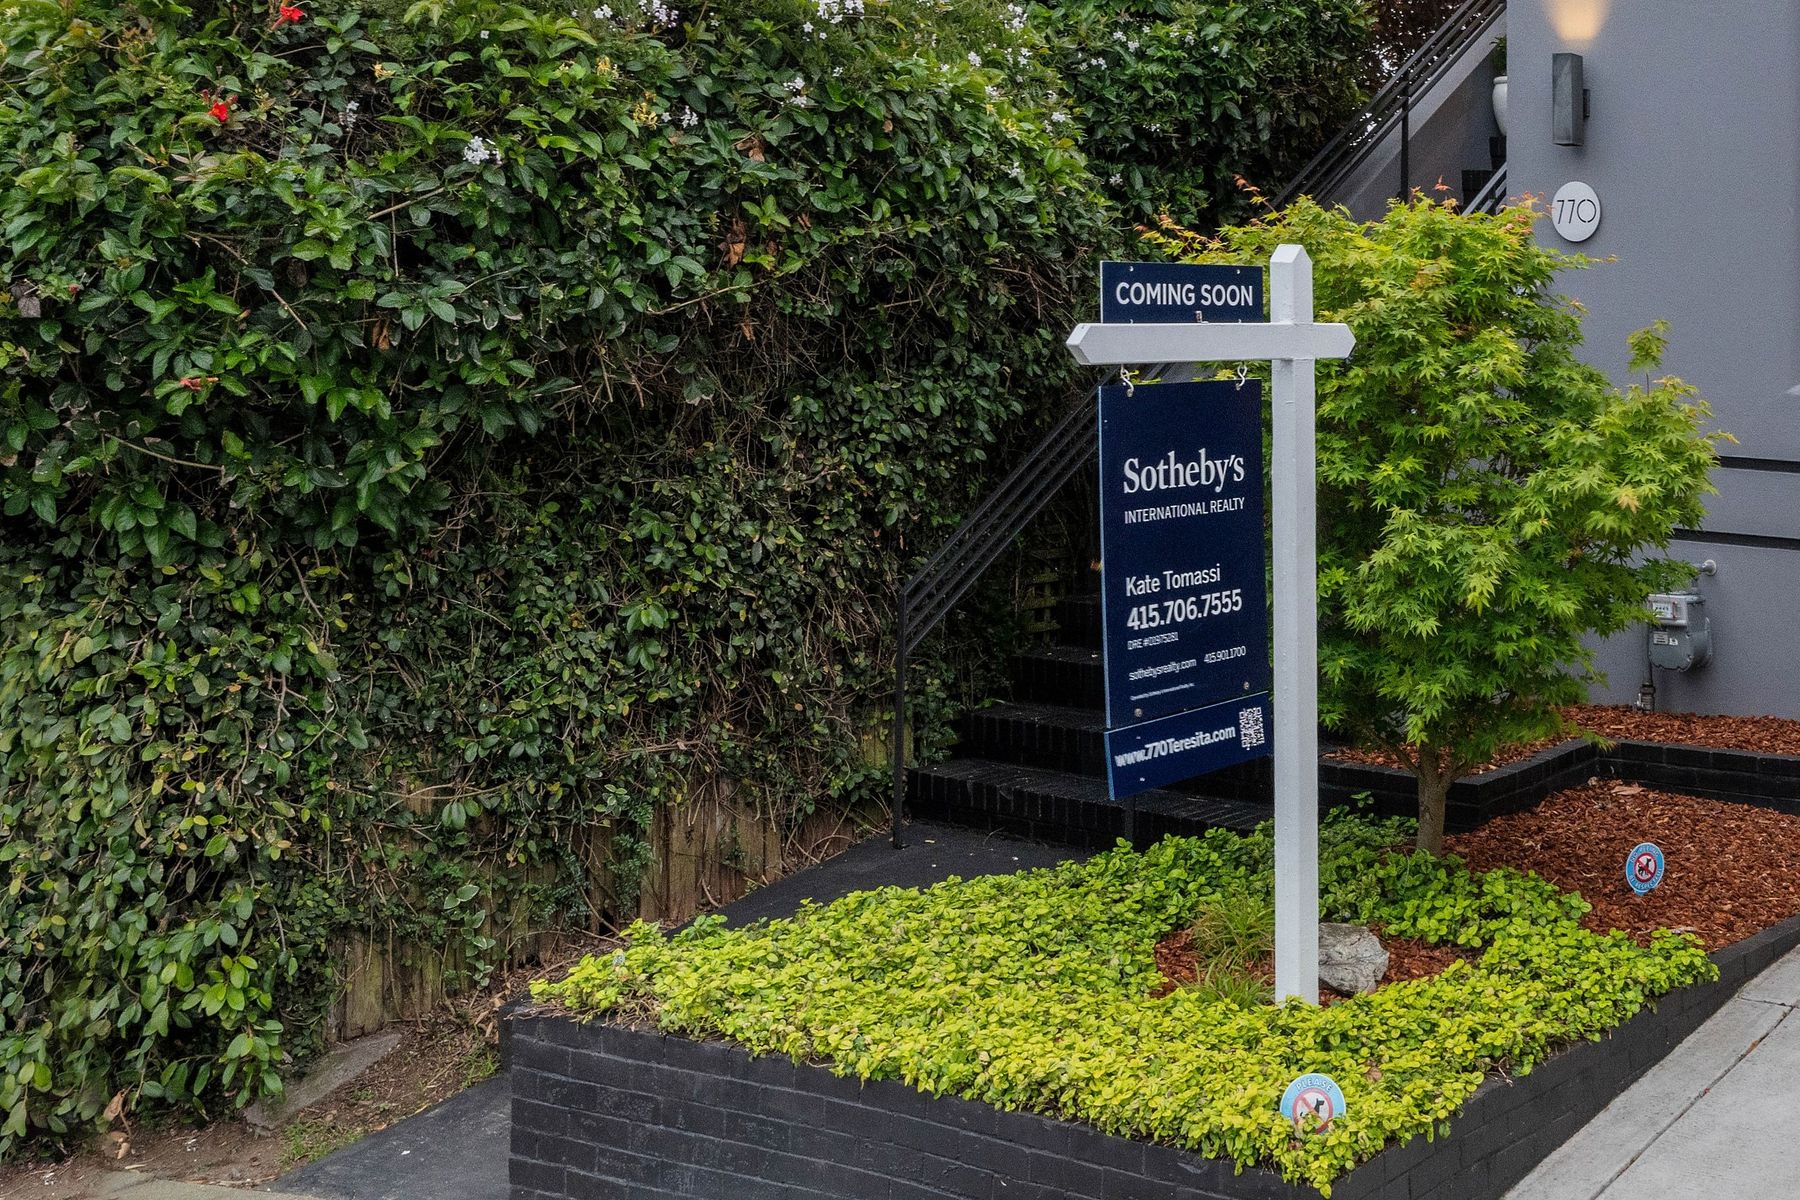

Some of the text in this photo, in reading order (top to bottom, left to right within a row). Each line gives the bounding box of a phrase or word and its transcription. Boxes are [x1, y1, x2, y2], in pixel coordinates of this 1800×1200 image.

[1556, 198, 1597, 225] 770
[1115, 281, 1254, 307] COMING SOON
[1122, 447, 1245, 494] Sotheby's
[1124, 496, 1245, 524] INTERNATIONAL REALTY
[1125, 563, 1221, 597] Kate Tomassi
[1126, 588, 1243, 631] 415.706.7555
[1128, 645, 1247, 681] sothebysrealty.com 415.901.1700
[1114, 725, 1237, 768] www.770Teresita.com
[1295, 1077, 1334, 1094] PLEASE
